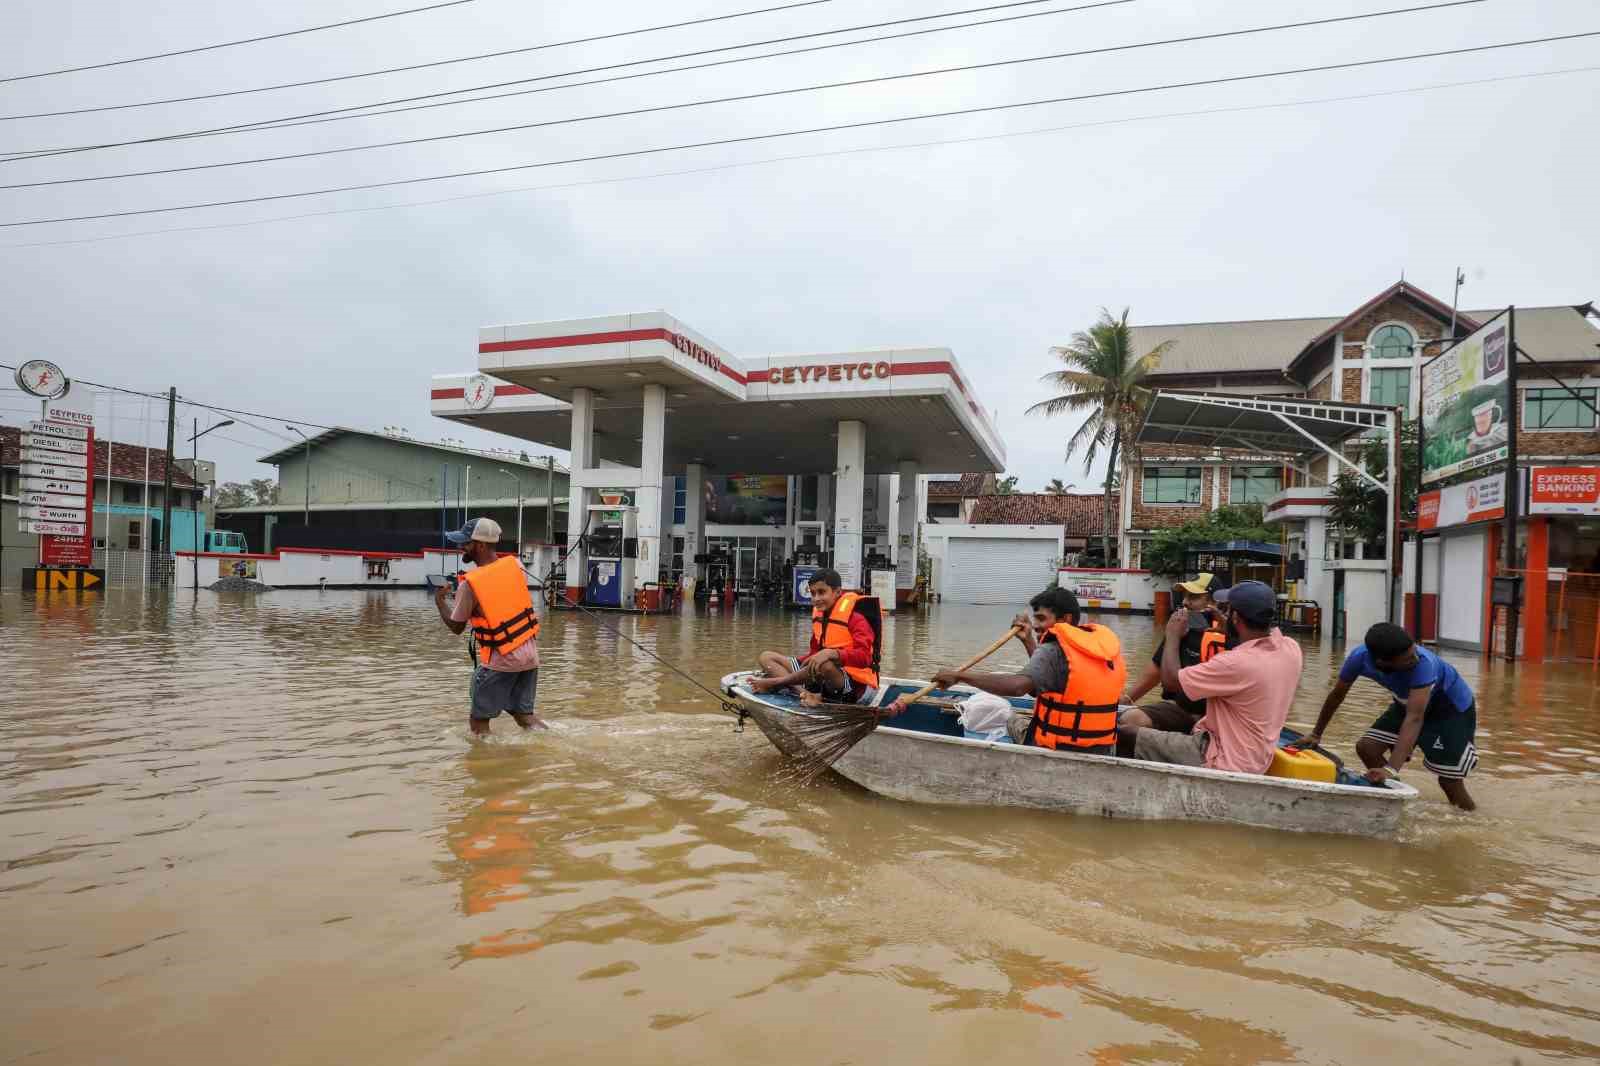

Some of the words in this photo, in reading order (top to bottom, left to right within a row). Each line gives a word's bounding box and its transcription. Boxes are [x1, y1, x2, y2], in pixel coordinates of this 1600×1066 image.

[674, 334, 720, 371] CEYPETCO
[768, 361, 892, 384] CEYPETCO
[50, 409, 92, 420] CEYPETCO
[33, 423, 65, 433] PETROL
[33, 439, 61, 447] DIESEL
[1537, 474, 1596, 483] EXPRESS
[1537, 483, 1595, 492] BANKING
[36, 570, 77, 589] IN
